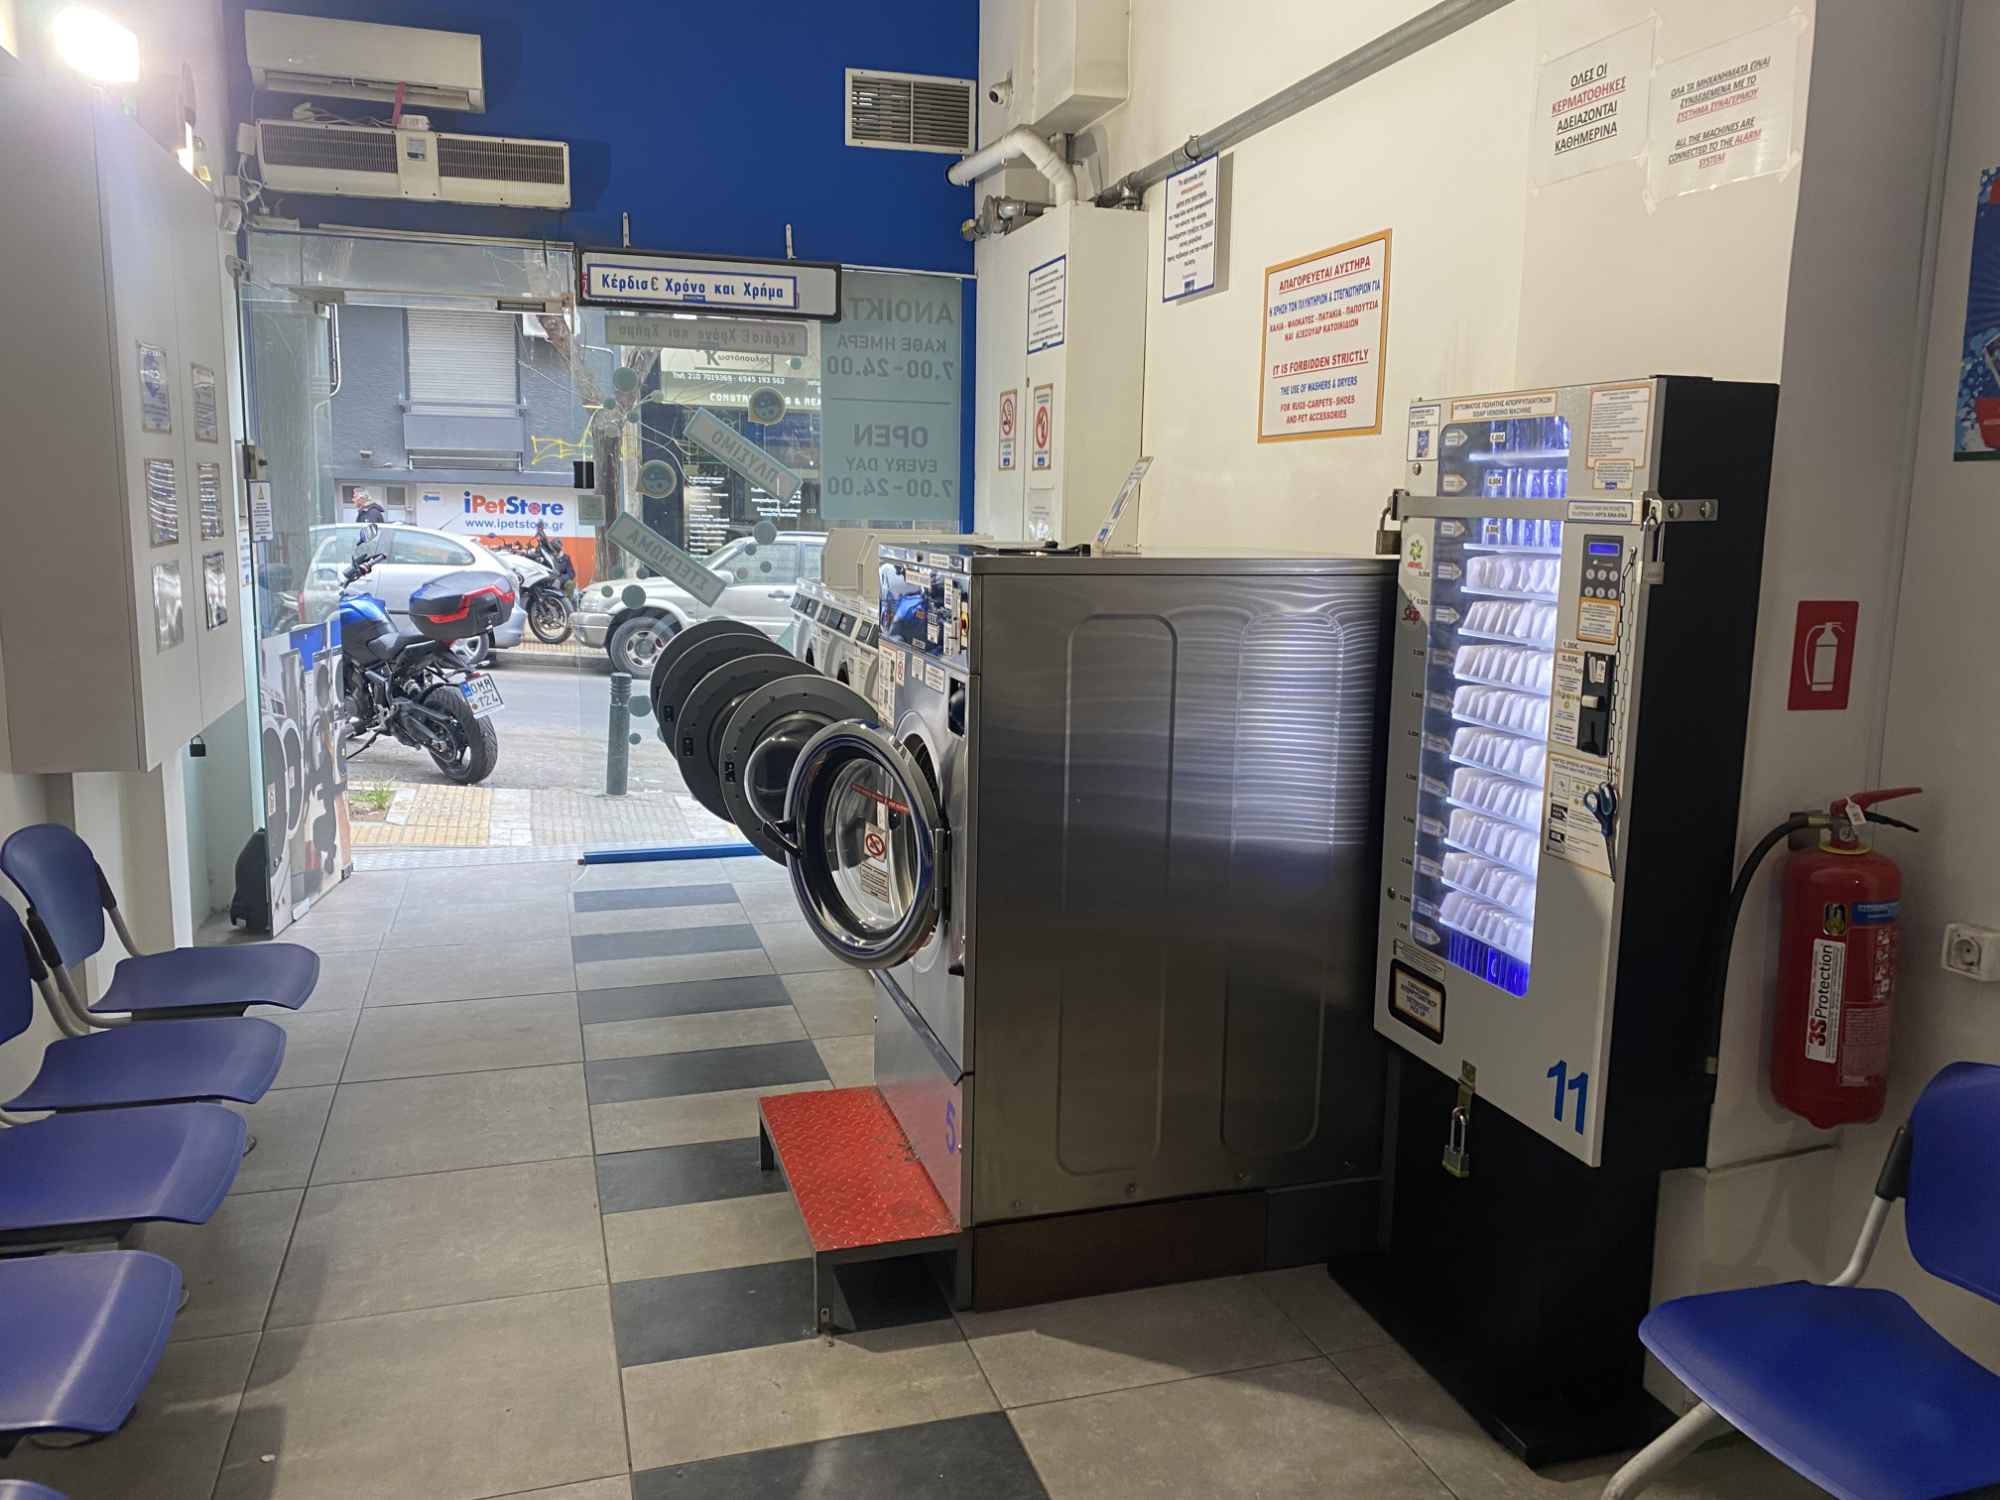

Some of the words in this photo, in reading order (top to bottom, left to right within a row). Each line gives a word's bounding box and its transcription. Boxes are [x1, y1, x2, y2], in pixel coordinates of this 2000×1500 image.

[1570, 68, 1594, 87] ΟΛΕΣ
[1596, 63, 1608, 77] ΟΙ
[1552, 76, 1626, 114] ΚΕΡΜΑΤΟΘΗΚΕΣ
[1556, 100, 1618, 132] ΑΔΕΙΑΖΟΝΤΑΙ
[1554, 121, 1617, 152] ΚΑΘΗΜΕΡΙΝΑ
[1668, 145, 1708, 164] CONNECTED
[1709, 141, 1719, 152] TO
[1720, 137, 1733, 148] THE
[1734, 128, 1762, 144] ALARM
[1675, 137, 1687, 148] ALL
[1689, 133, 1701, 144] THE
[1703, 121, 1739, 140] MACHINES
[1740, 116, 1755, 129] ARE
[665, 278, 705, 294] Χρόνο
[714, 282, 735, 295] και
[744, 282, 784, 299] Χρήμα
[1280, 267, 1333, 290] ΑΠΑΓΟΡΕΥΕΤΑΙ
[1334, 256, 1370, 274] ΑΥΣΤΗΡΑ
[1272, 364, 1280, 376] IT
[1281, 363, 1288, 374] IS
[1289, 356, 1330, 373] FORBIDDEN
[1332, 349, 1368, 366] STRICTLY
[1307, 379, 1331, 392] WASHERS
[463, 490, 564, 516] iPetStore
[1546, 1059, 1589, 1136] 11
